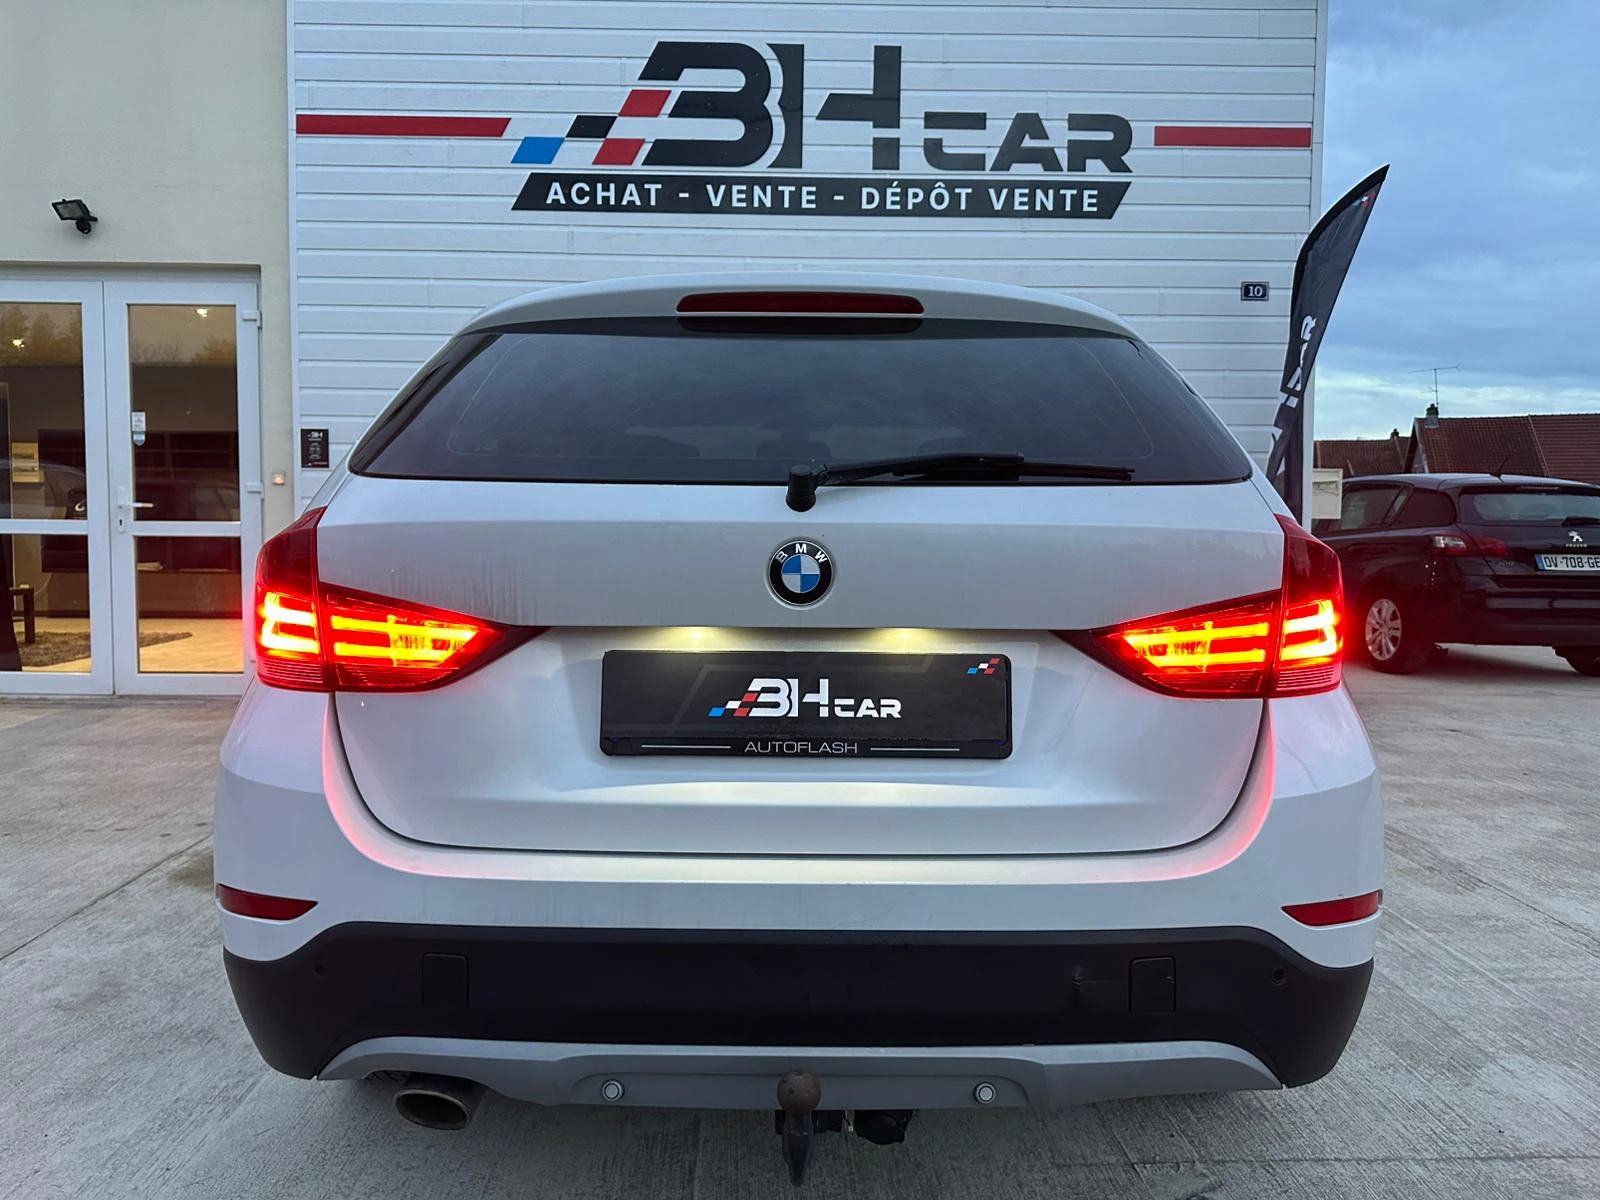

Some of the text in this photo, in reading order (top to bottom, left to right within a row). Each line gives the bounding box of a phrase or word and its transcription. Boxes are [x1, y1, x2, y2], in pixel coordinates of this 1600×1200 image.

[546, 182, 661, 206] ACHAT
[706, 185, 817, 209] VENTE
[861, 182, 972, 210] DÉPÔT
[988, 190, 1099, 212] VENTE
[1248, 285, 1263, 298] 10
[775, 543, 828, 564] BMW
[744, 741, 858, 754] AUTOFLASH
